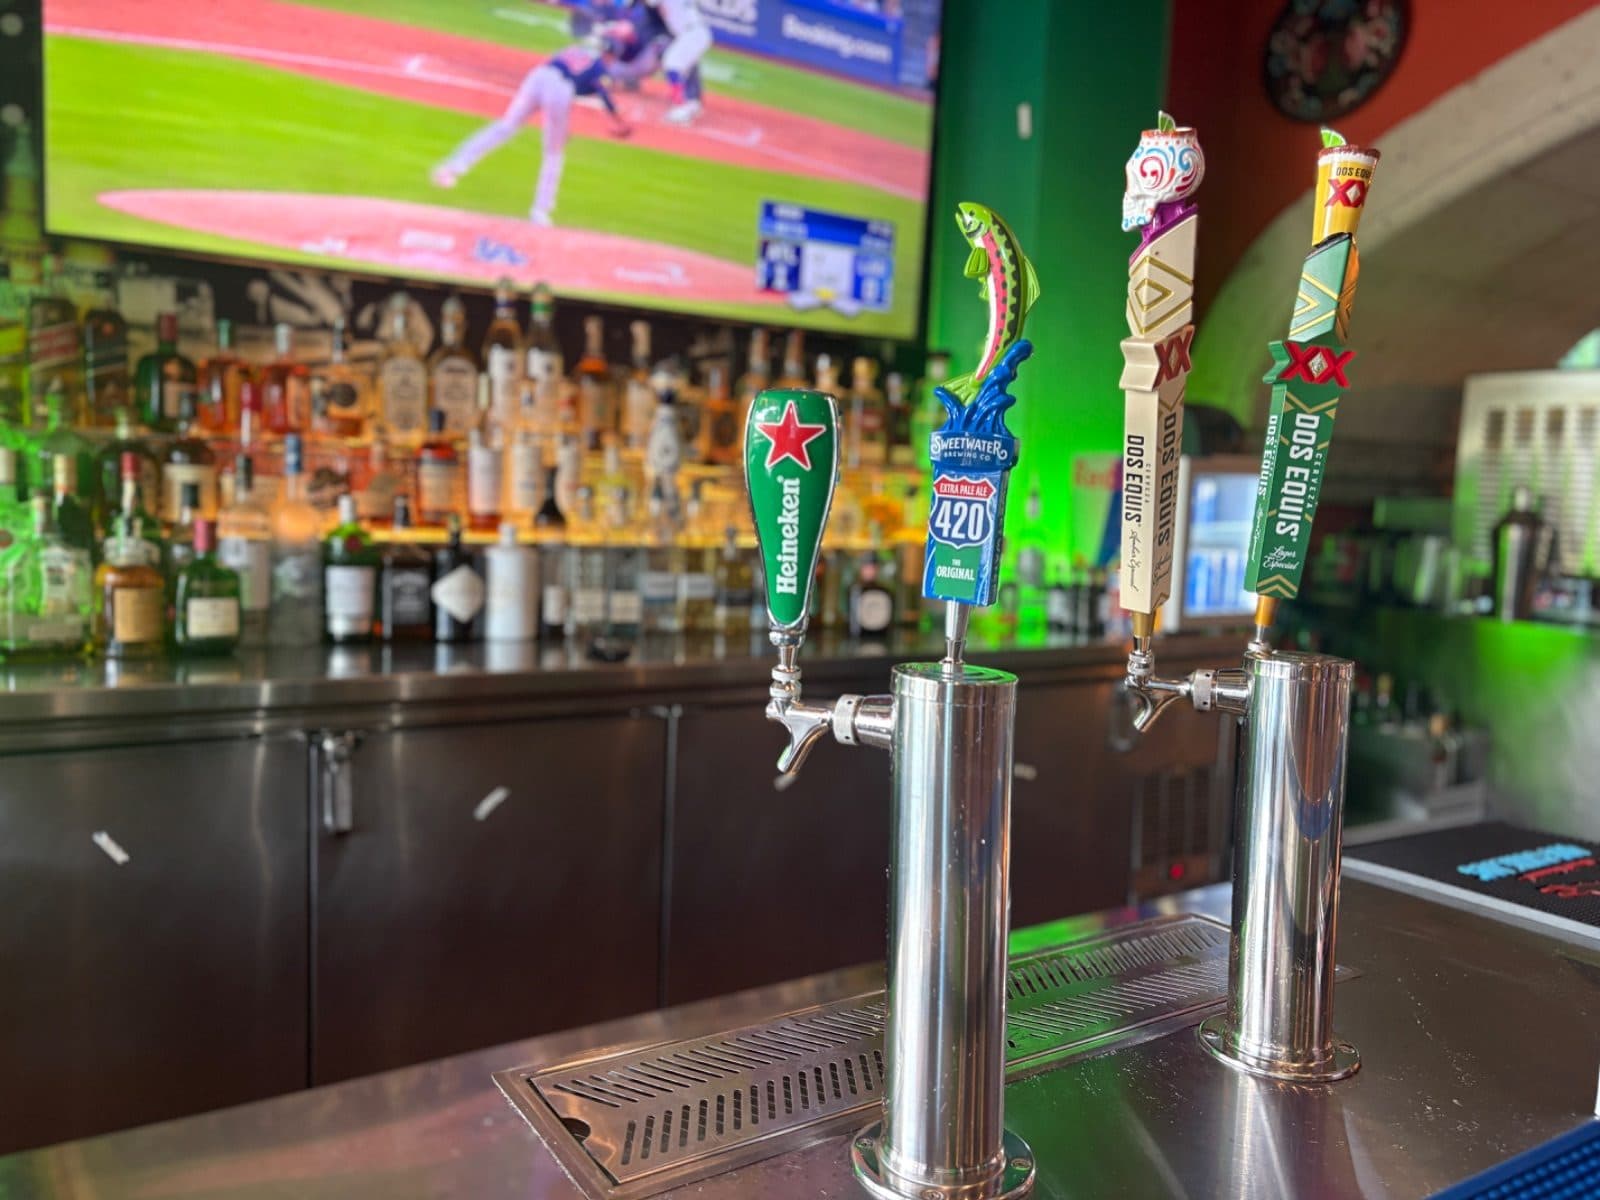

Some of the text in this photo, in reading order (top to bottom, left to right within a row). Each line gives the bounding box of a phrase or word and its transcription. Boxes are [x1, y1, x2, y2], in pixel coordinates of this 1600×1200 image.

[1336, 166, 1354, 177] DOS
[1152, 329, 1194, 391] XX
[1280, 341, 1358, 389] XX
[930, 435, 1008, 460] SWEETWATER
[1161, 412, 1177, 465] DOS
[1265, 415, 1278, 446] DOS
[944, 450, 977, 459] BREWING
[1258, 449, 1273, 496] EQUIS
[1275, 412, 1321, 537] DOS EQUIS
[939, 483, 988, 497] EXTRA PALE ALE
[1124, 434, 1145, 523] DOS EQUIS
[1305, 452, 1324, 509] CERVEZA
[935, 500, 985, 541] 420
[1157, 469, 1175, 547] EQUIS
[775, 478, 801, 595] Heineken
[936, 565, 975, 581] ORIGINAL
[951, 558, 961, 567] THE
